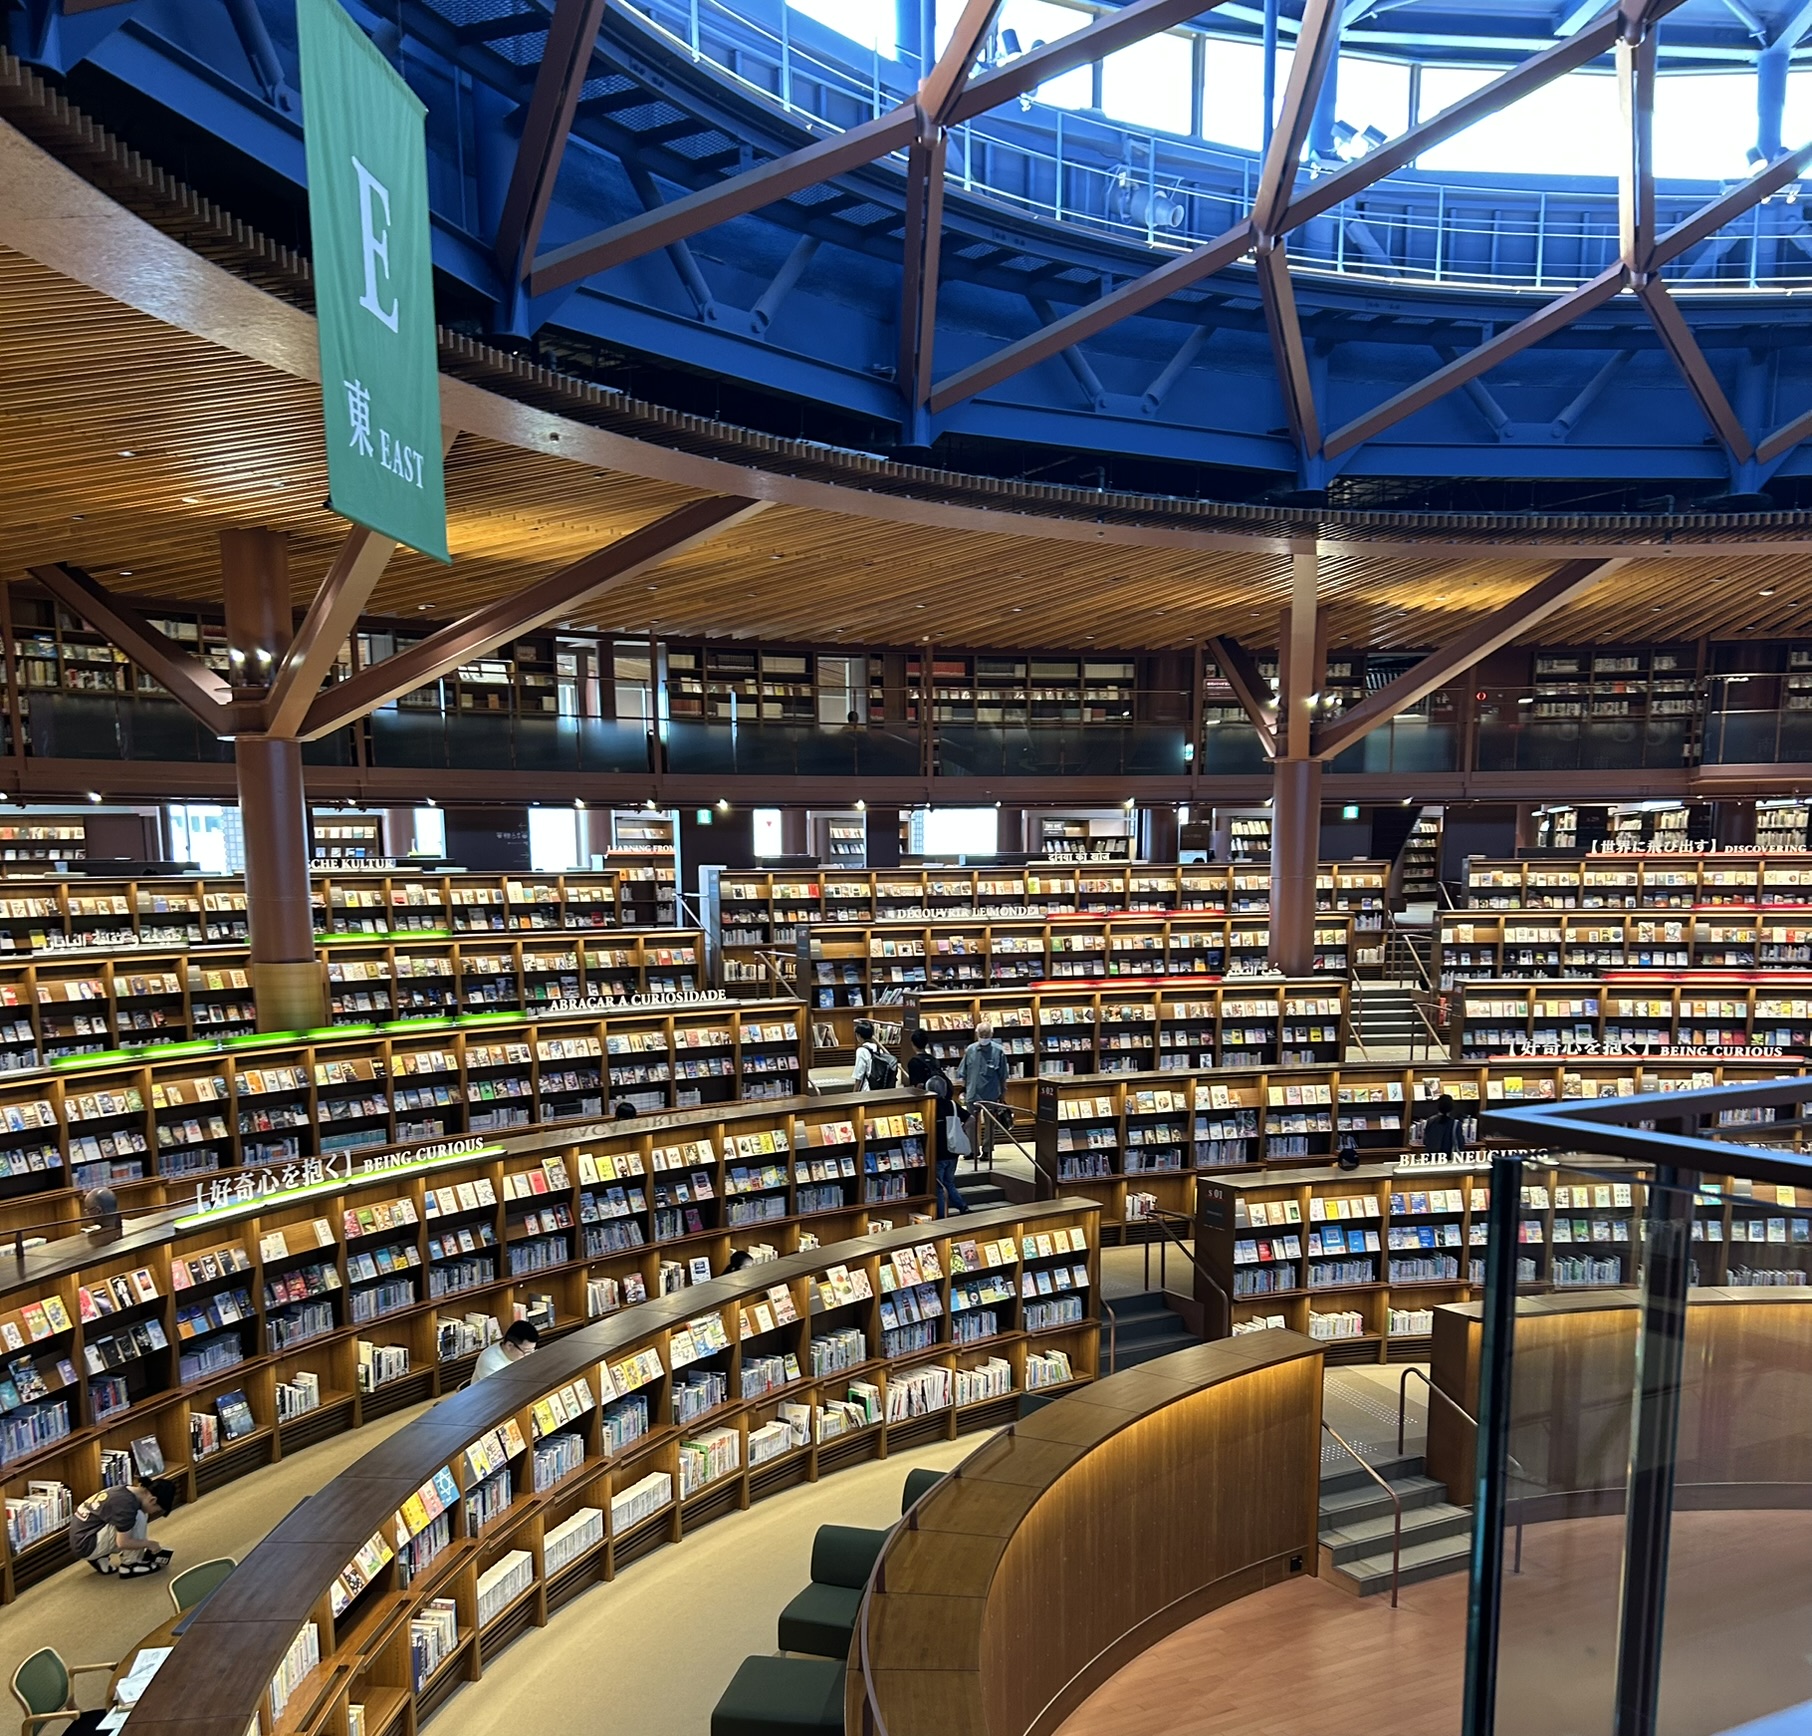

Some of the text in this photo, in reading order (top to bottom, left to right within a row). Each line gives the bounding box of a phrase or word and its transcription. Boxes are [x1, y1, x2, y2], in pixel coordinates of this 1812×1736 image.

[351, 155, 399, 334] E
[343, 378, 374, 458] 東
[379, 428, 424, 489] EAST
[1724, 844, 1807, 853] DISCOVERING
[341, 858, 396, 870] KULTUR
[972, 906, 988, 917] LE
[987, 905, 1035, 917] MONDE
[550, 989, 727, 1013] ABRAÇAR A CURIOSIDADE
[1507, 1037, 1783, 1058] 【好奇心を抱く】 BEING CURIOUS
[1399, 1152, 1449, 1167] BLEIB
[195, 1136, 485, 1215] 【好奇心を抱く】 BEING CURIOUS
